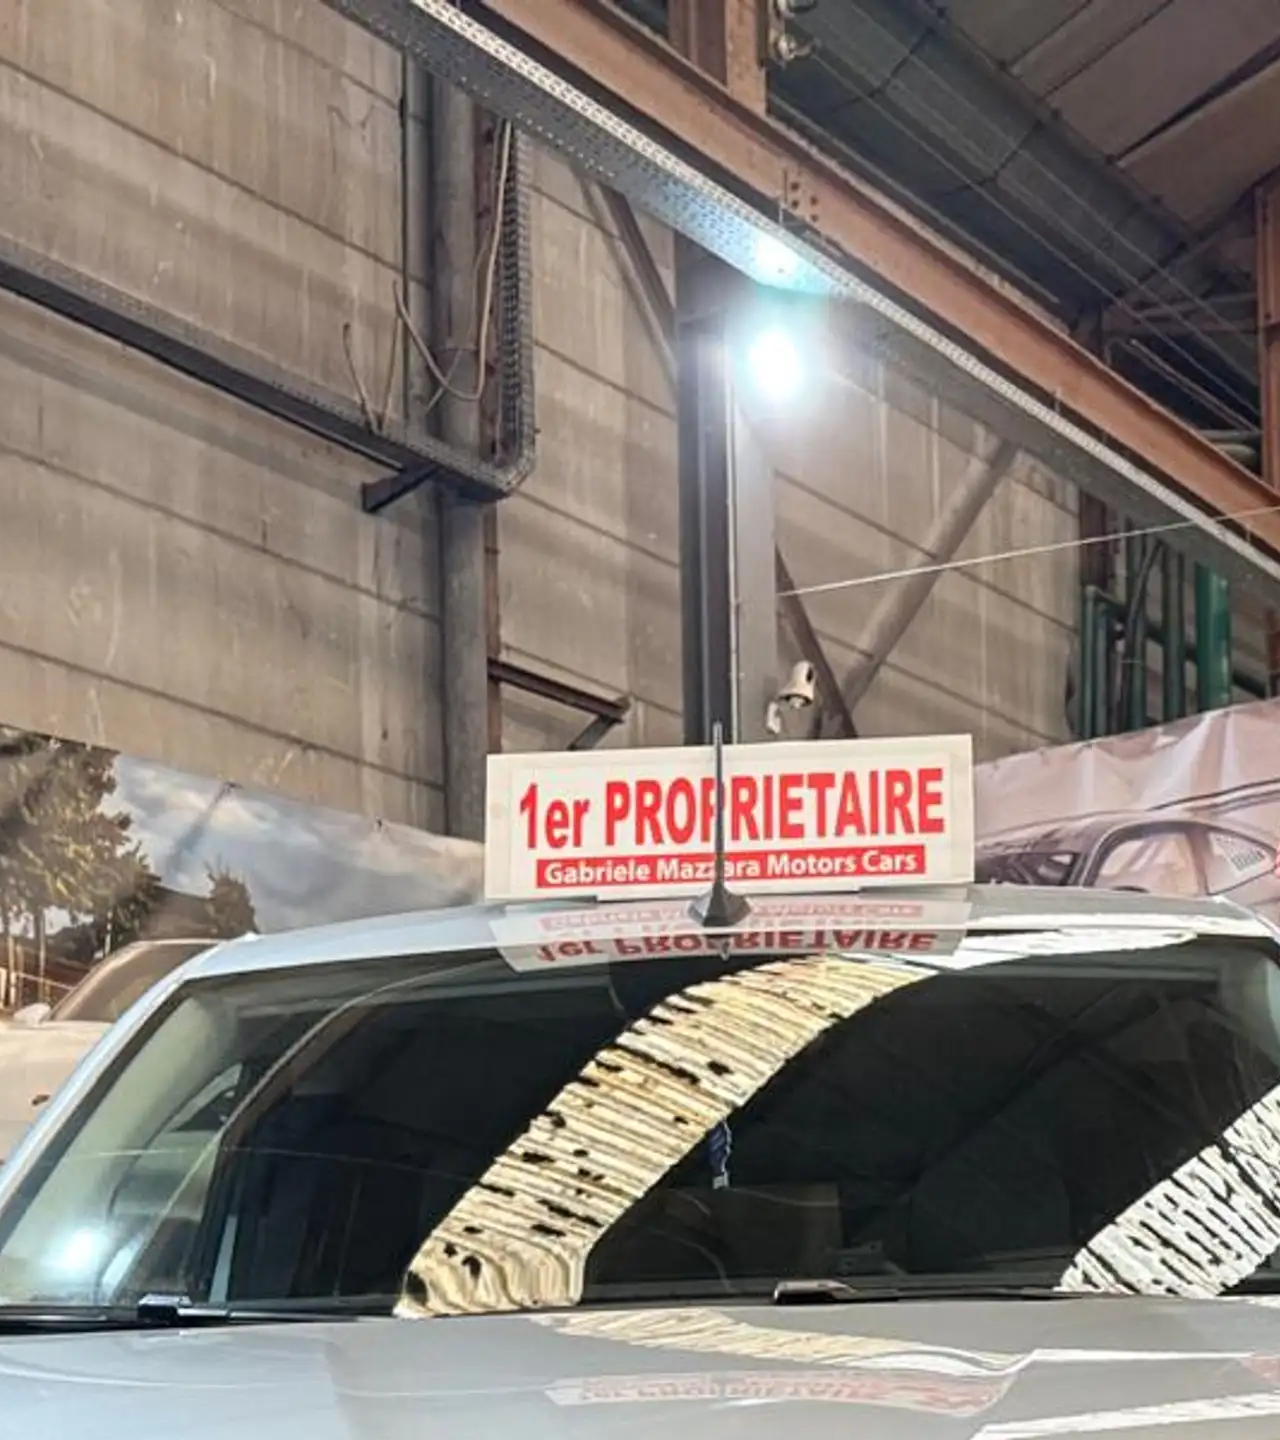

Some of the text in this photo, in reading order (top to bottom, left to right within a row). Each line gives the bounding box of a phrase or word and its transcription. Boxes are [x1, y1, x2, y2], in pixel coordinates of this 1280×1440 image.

[520, 768, 945, 849] 1er PROPRIETAIRE
[544, 861, 649, 885] Gabriele
[767, 852, 857, 877] Motors
[862, 849, 918, 873] Cars
